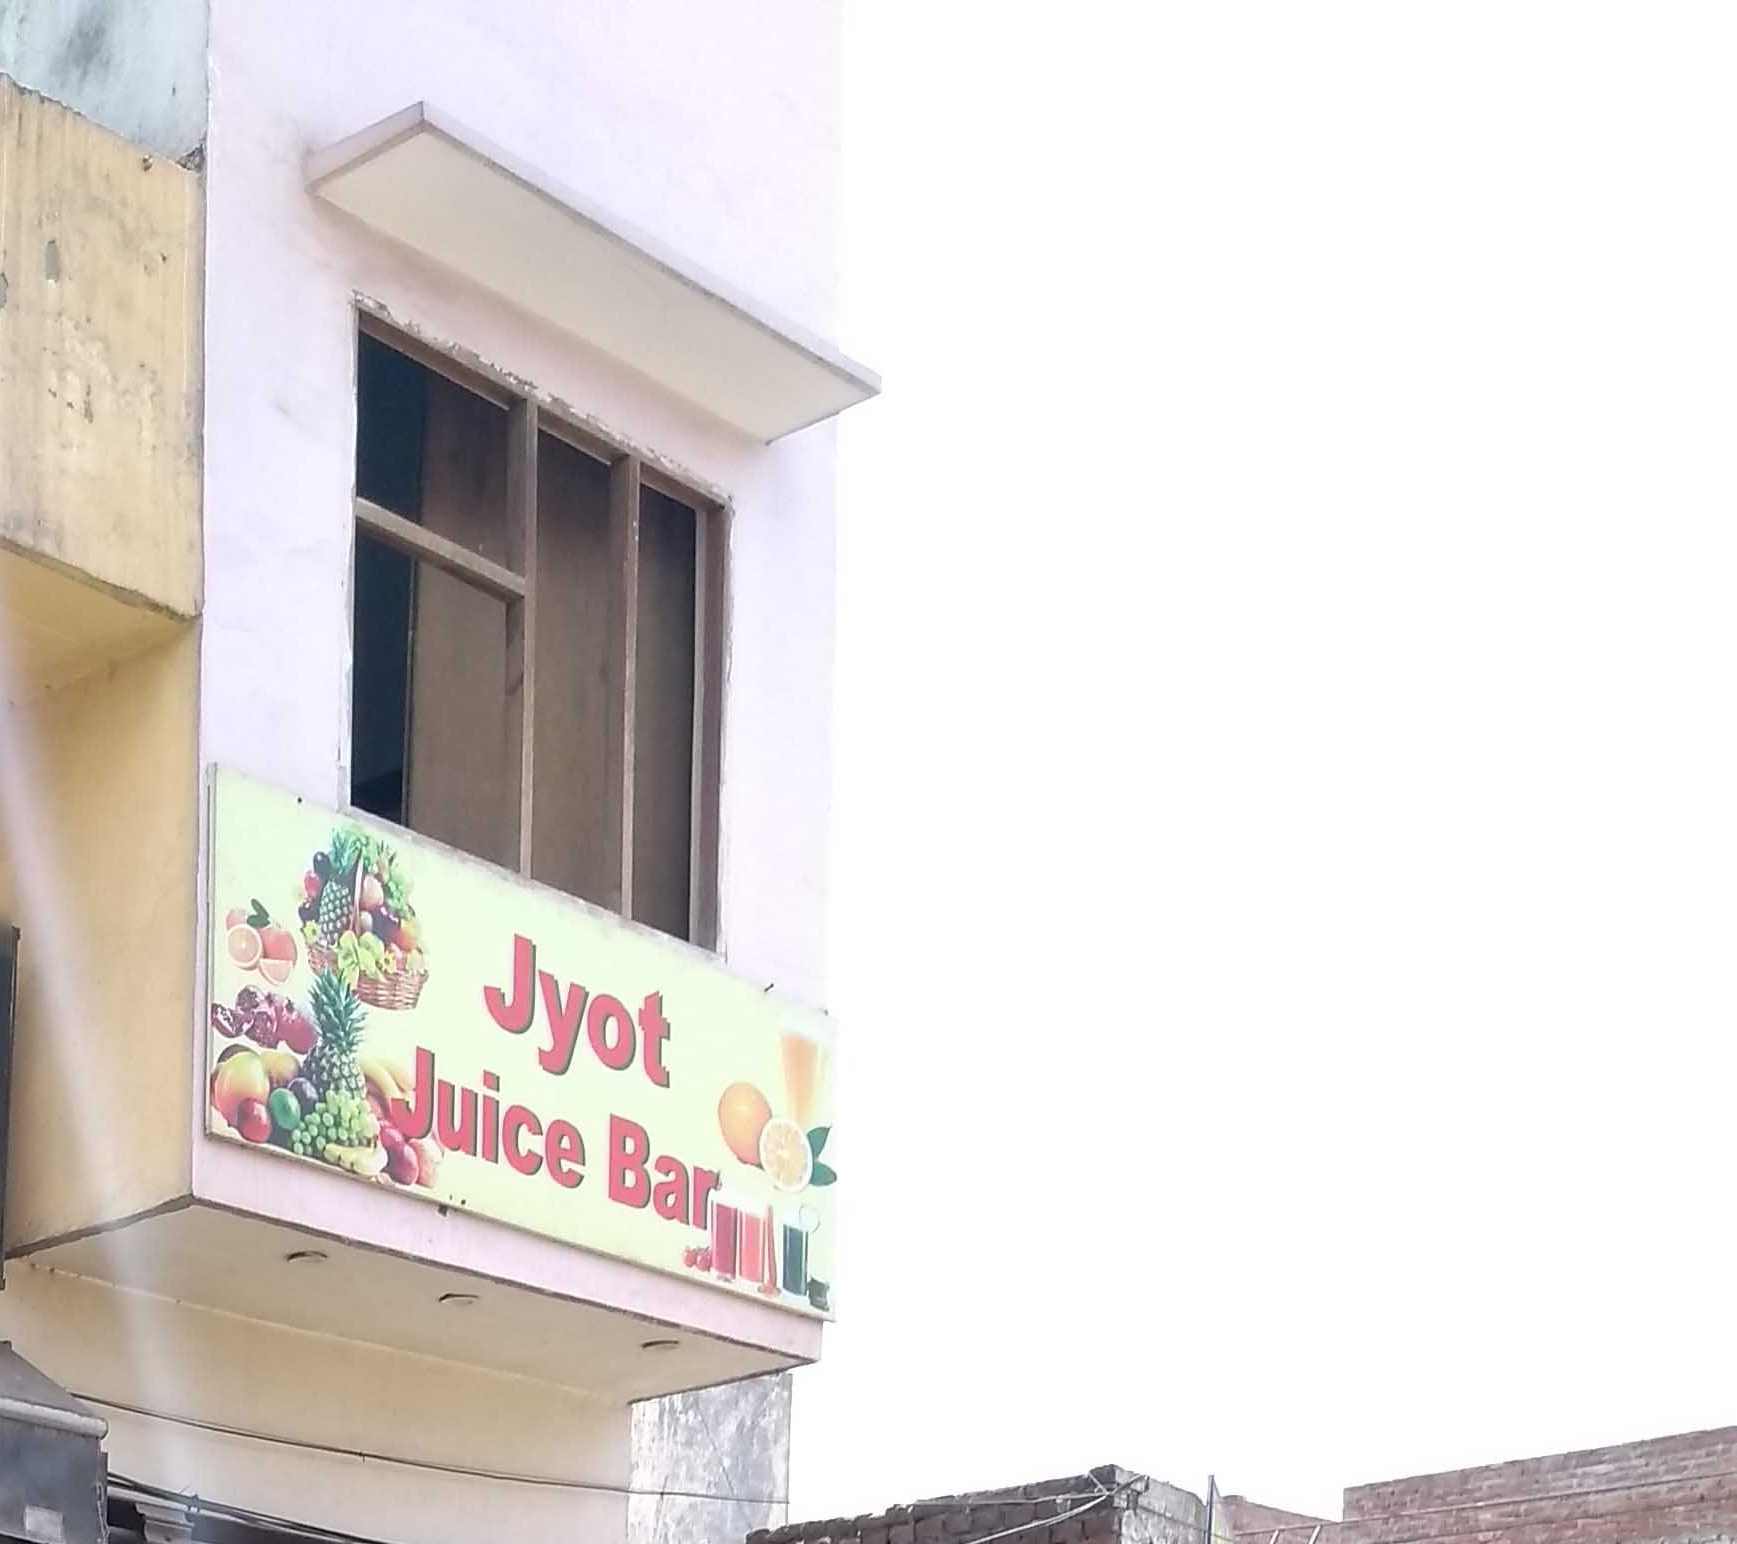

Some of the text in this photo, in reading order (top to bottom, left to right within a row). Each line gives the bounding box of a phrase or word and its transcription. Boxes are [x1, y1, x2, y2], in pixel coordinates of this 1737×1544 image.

[482, 933, 671, 1088] Jyot
[390, 1046, 720, 1230] Juice Bar
